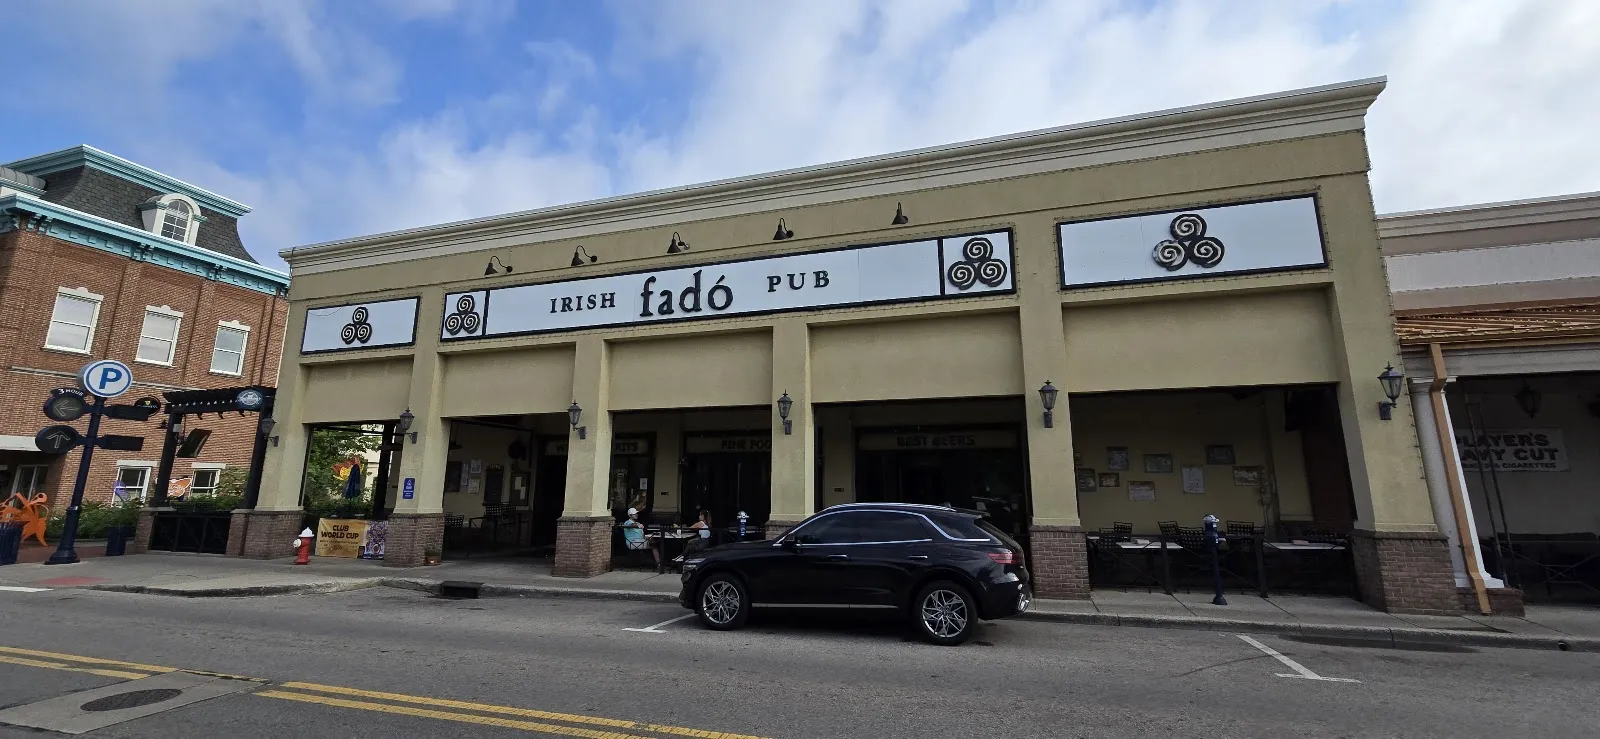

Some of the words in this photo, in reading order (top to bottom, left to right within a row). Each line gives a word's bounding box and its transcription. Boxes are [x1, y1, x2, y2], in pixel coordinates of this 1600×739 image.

[550, 292, 616, 314] IRISH
[639, 269, 734, 317] fadó
[766, 270, 830, 293] PUB
[98, 367, 123, 390] P
[65, 389, 84, 397] HOUR
[896, 435, 927, 446] BEST
[931, 434, 975, 446] BEERS
[1460, 449, 1506, 461] AVY
[1513, 448, 1559, 461] CUT
[332, 524, 350, 532] CLUB
[321, 531, 345, 539] WORLD
[345, 532, 360, 540] CUP
